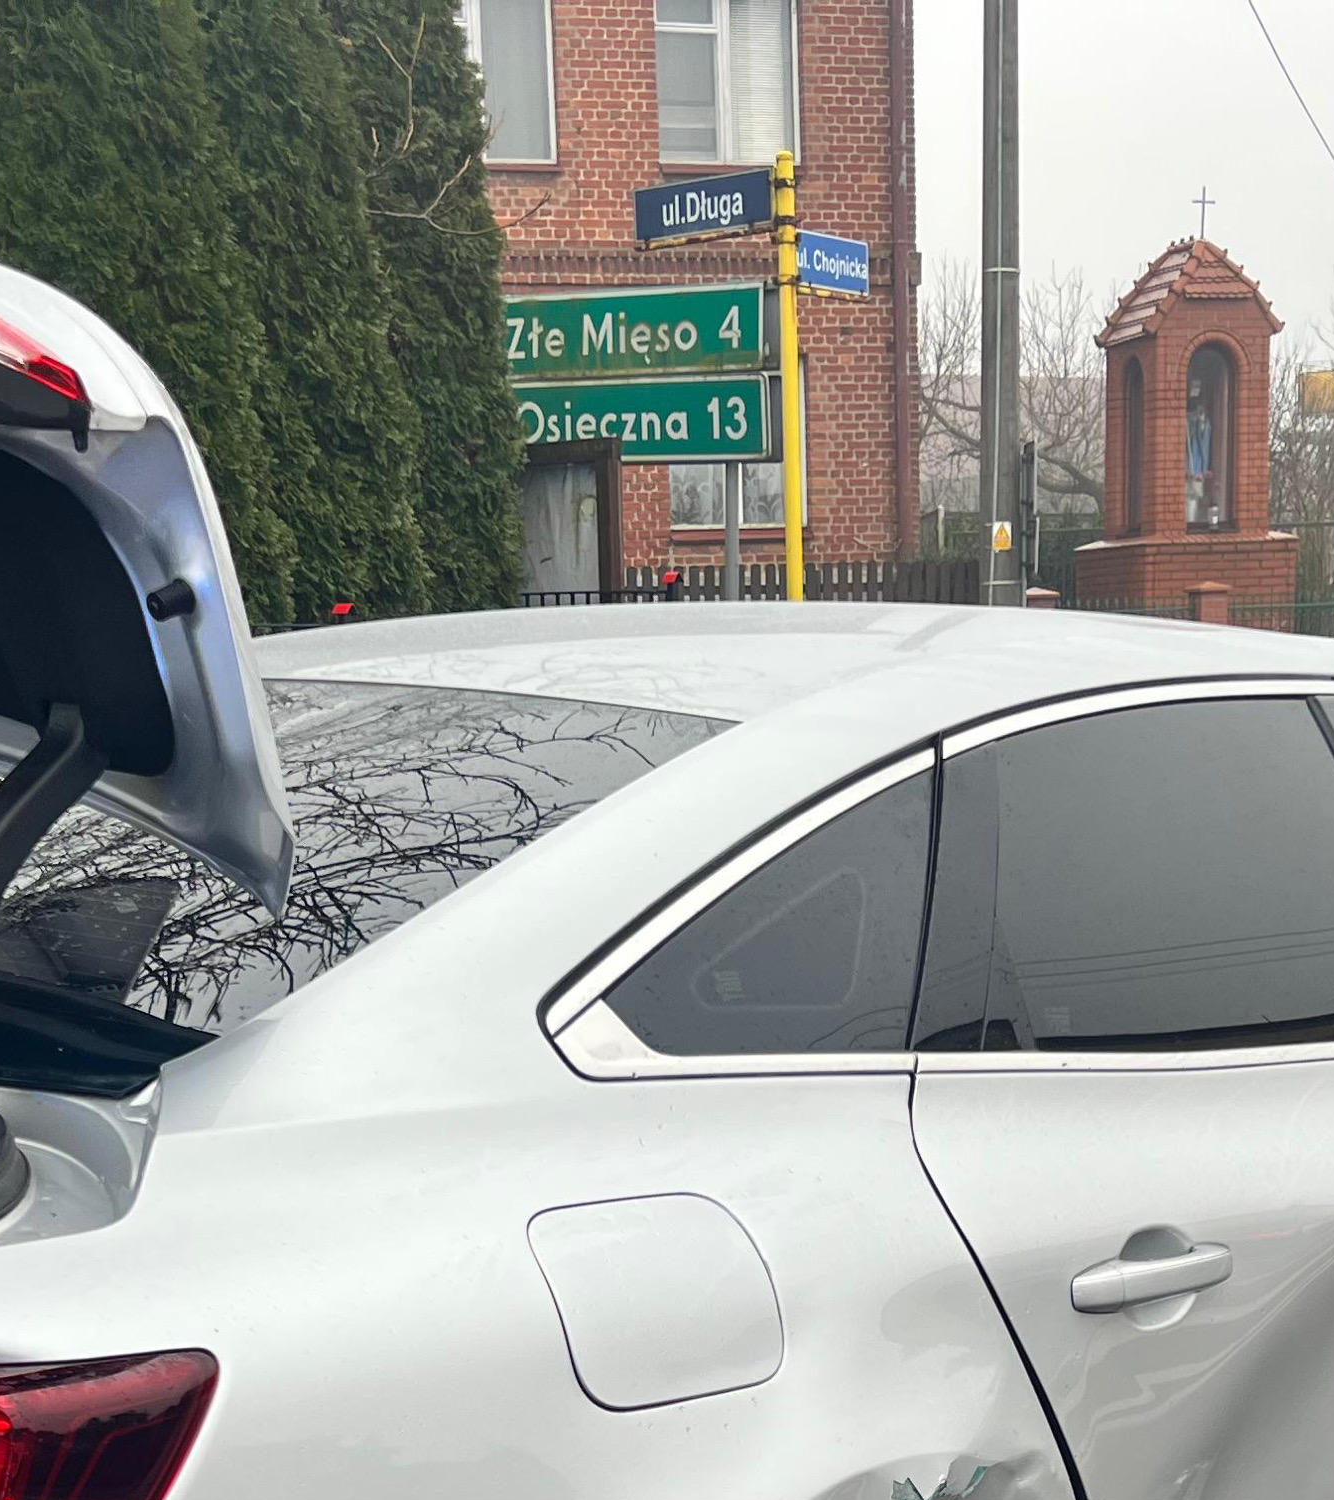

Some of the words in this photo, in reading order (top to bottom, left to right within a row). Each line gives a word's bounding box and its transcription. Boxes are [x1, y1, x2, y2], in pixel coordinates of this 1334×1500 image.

[662, 190, 744, 227] ul.Długa
[796, 247, 811, 270] ul.
[813, 249, 868, 281] Chojnicka
[506, 316, 565, 360] Złe
[581, 311, 698, 366] Mięso
[718, 304, 742, 349] 4
[516, 401, 690, 445] Osieczna
[706, 396, 748, 441] 13
